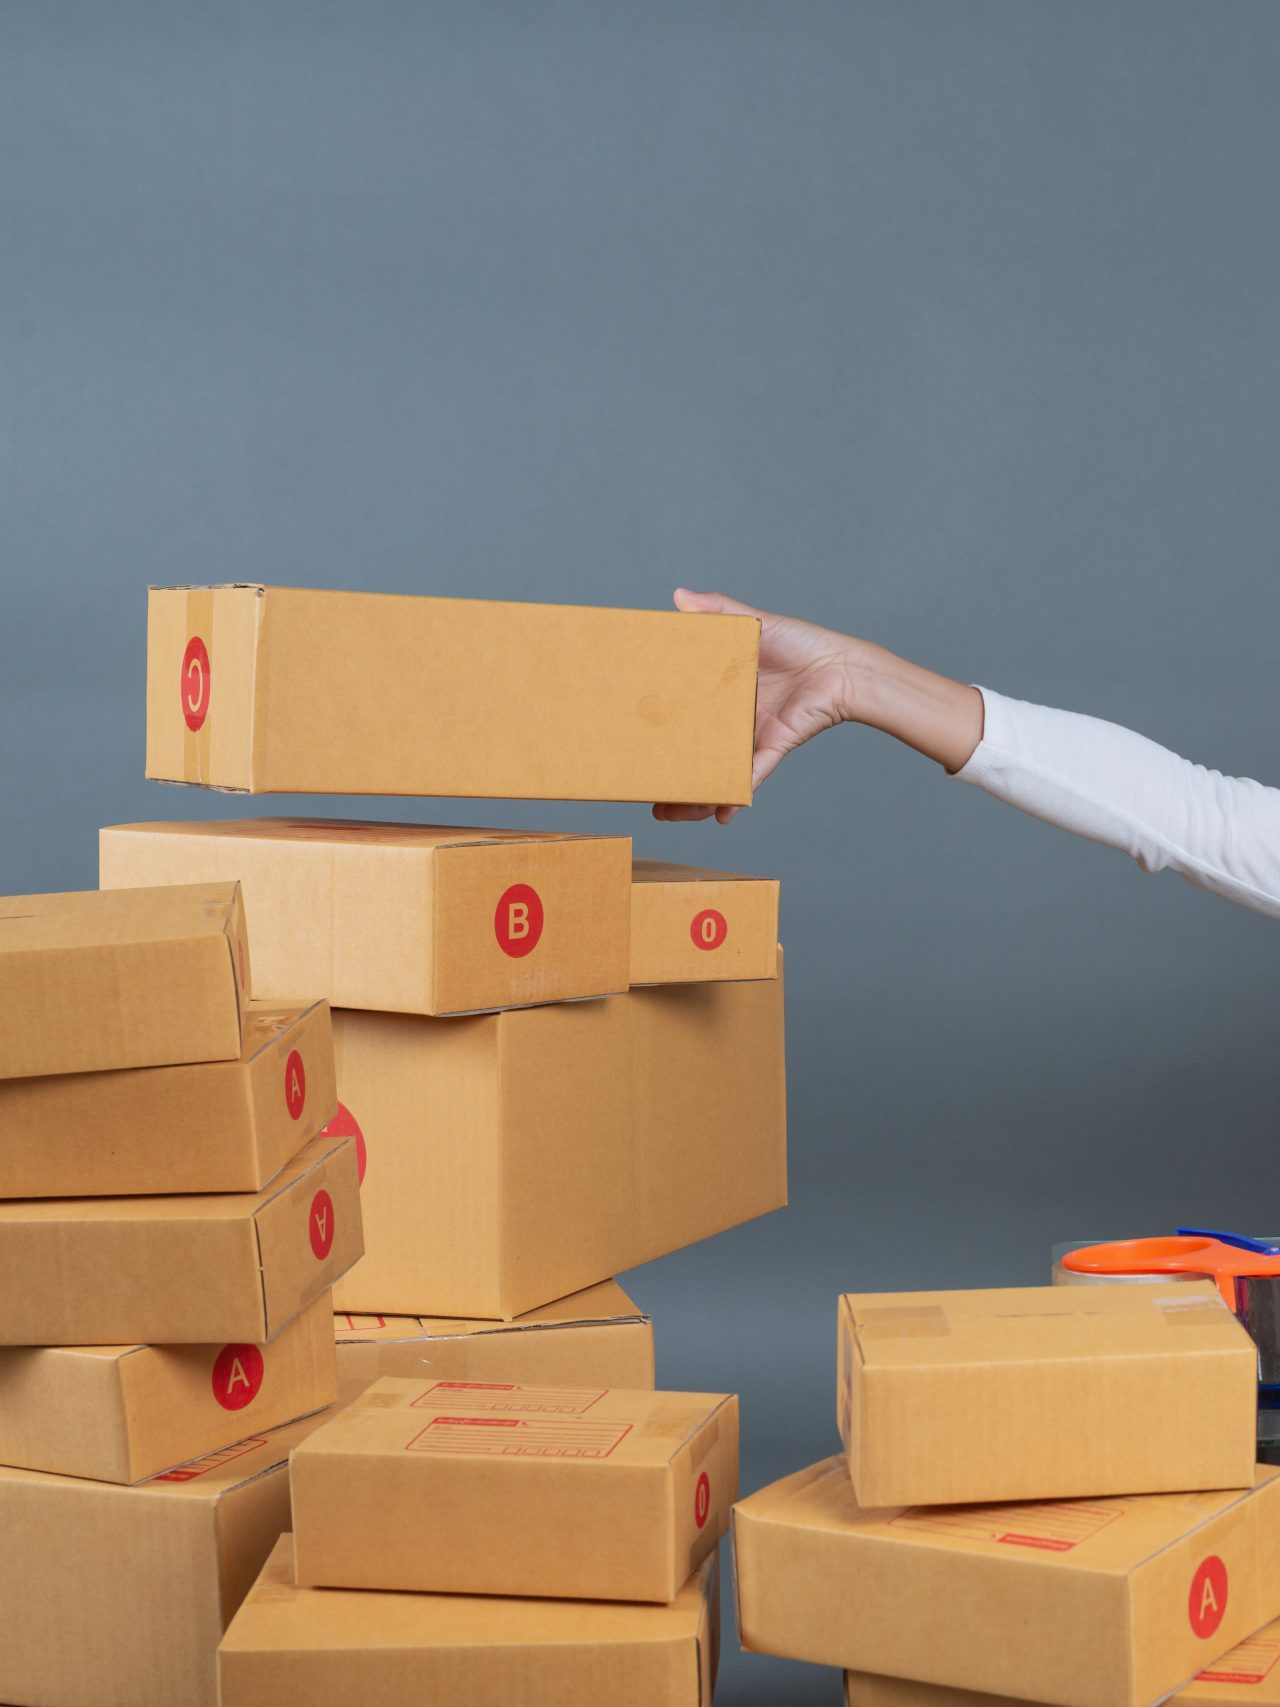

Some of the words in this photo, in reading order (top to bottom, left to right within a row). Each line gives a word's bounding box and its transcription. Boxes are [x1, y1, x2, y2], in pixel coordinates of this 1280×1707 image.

[188, 658, 203, 713] C
[508, 902, 530, 940] B
[291, 1068, 301, 1103] A
[315, 1206, 327, 1242] A
[226, 1357, 250, 1394] A
[1199, 1577, 1218, 1620] A
